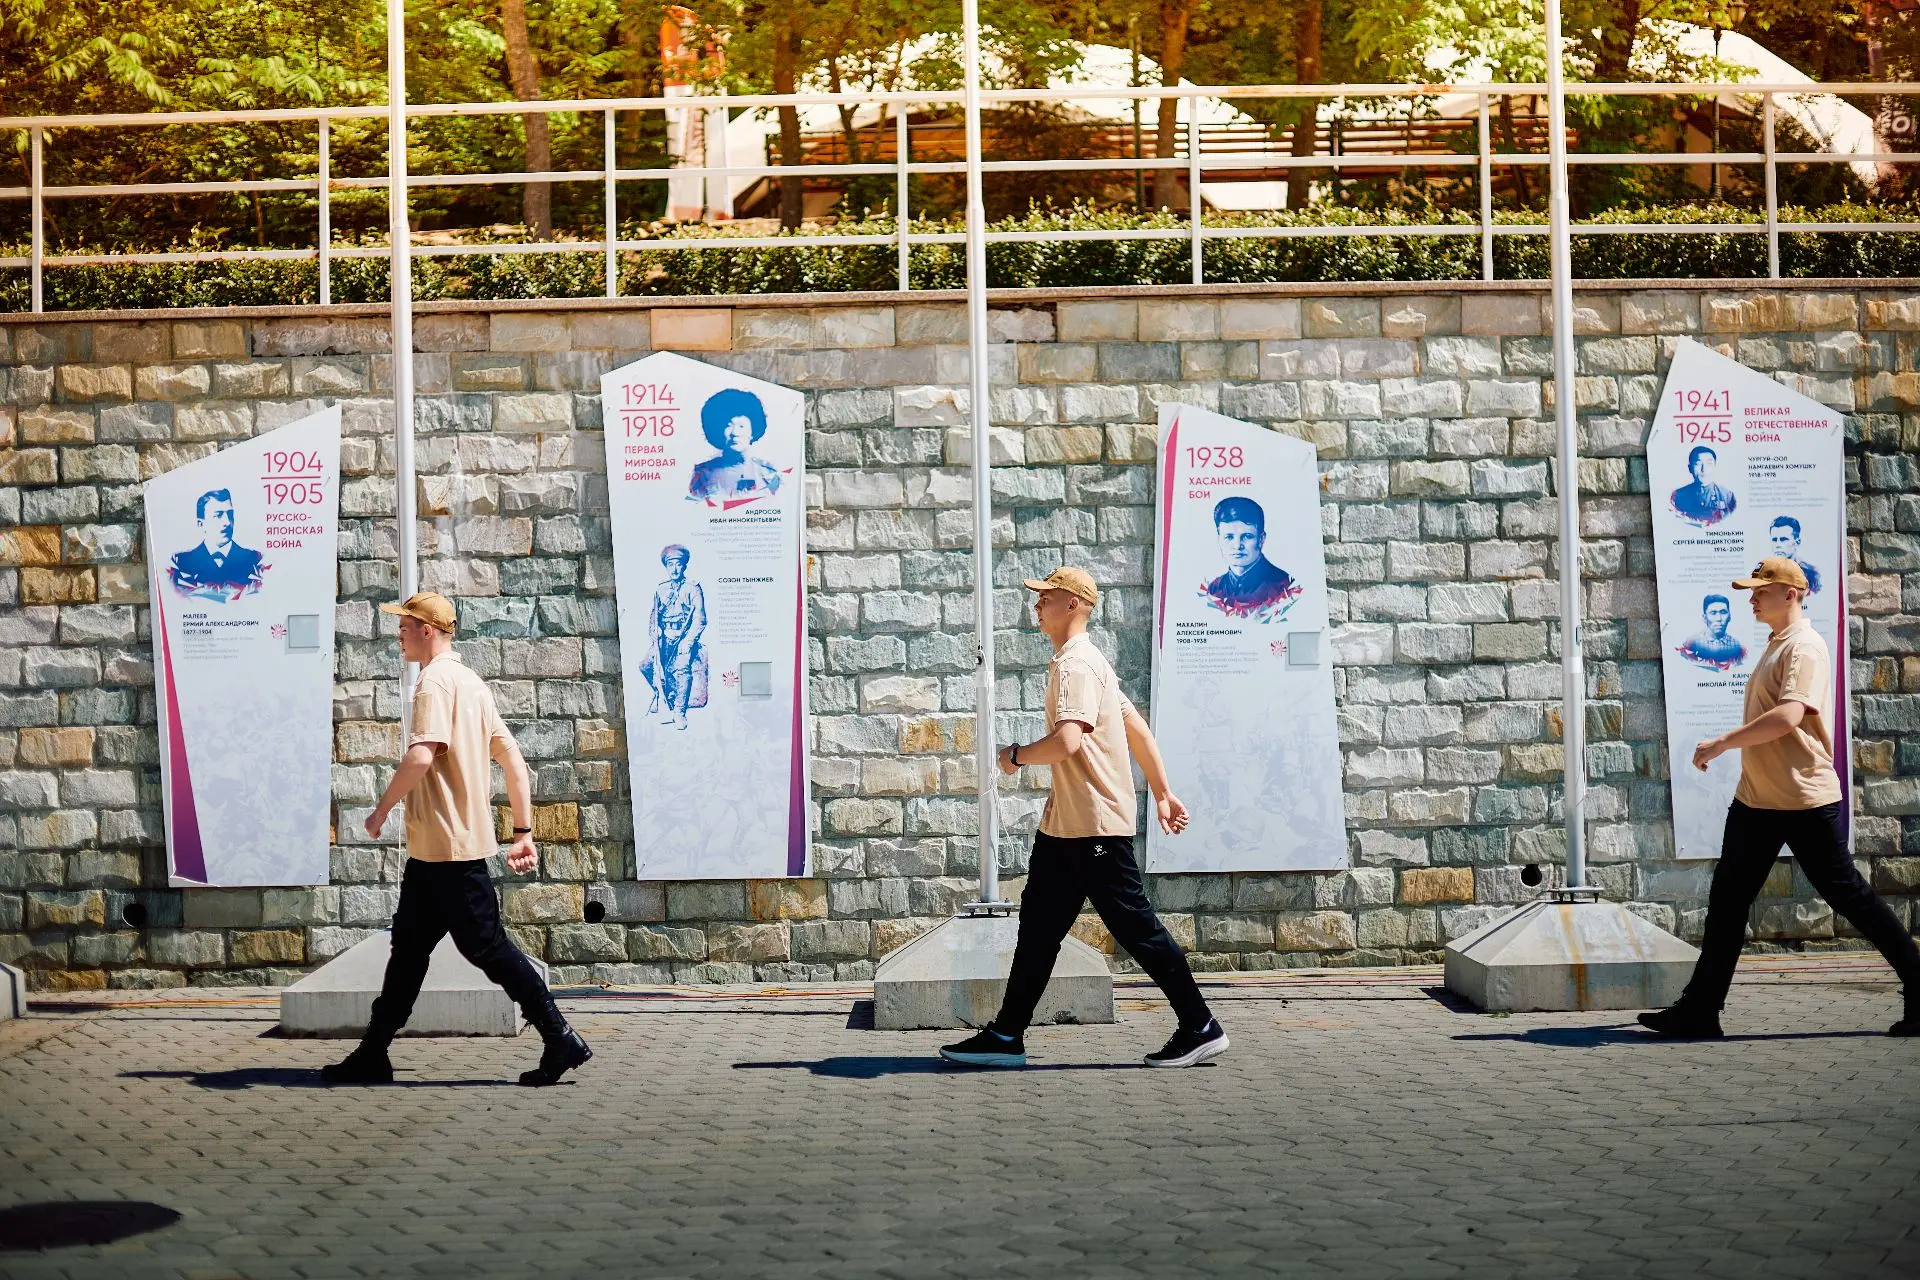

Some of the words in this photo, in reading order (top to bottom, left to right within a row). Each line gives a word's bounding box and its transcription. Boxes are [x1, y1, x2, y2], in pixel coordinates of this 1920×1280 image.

[621, 383, 675, 405] 1914
[1674, 390, 1731, 411] 1941
[1744, 407, 1791, 416] ВЕЛИКАЯ
[621, 415, 675, 438] 1918
[1744, 420, 1828, 429] ОТЕЧЕСТВЕННАЯ
[1675, 421, 1732, 443] 1945
[1745, 431, 1781, 442] ВОЙНА
[624, 445, 664, 454] ПЕРВАЯ
[263, 451, 323, 473] 1904
[624, 457, 676, 468] МИРОВАЯ
[1186, 446, 1244, 469] 1938
[624, 469, 662, 482] ВОЙНА
[1188, 476, 1252, 486] ХАСАНСКИЕ
[263, 483, 323, 505] 1905
[1188, 490, 1211, 499] БОИ
[266, 513, 312, 523] РУССКО-
[266, 525, 323, 535] ЯПОНСКАЯ
[266, 537, 303, 549] ВОЙНА
[1176, 628, 1205, 636] АЛЕКСЕЙ
